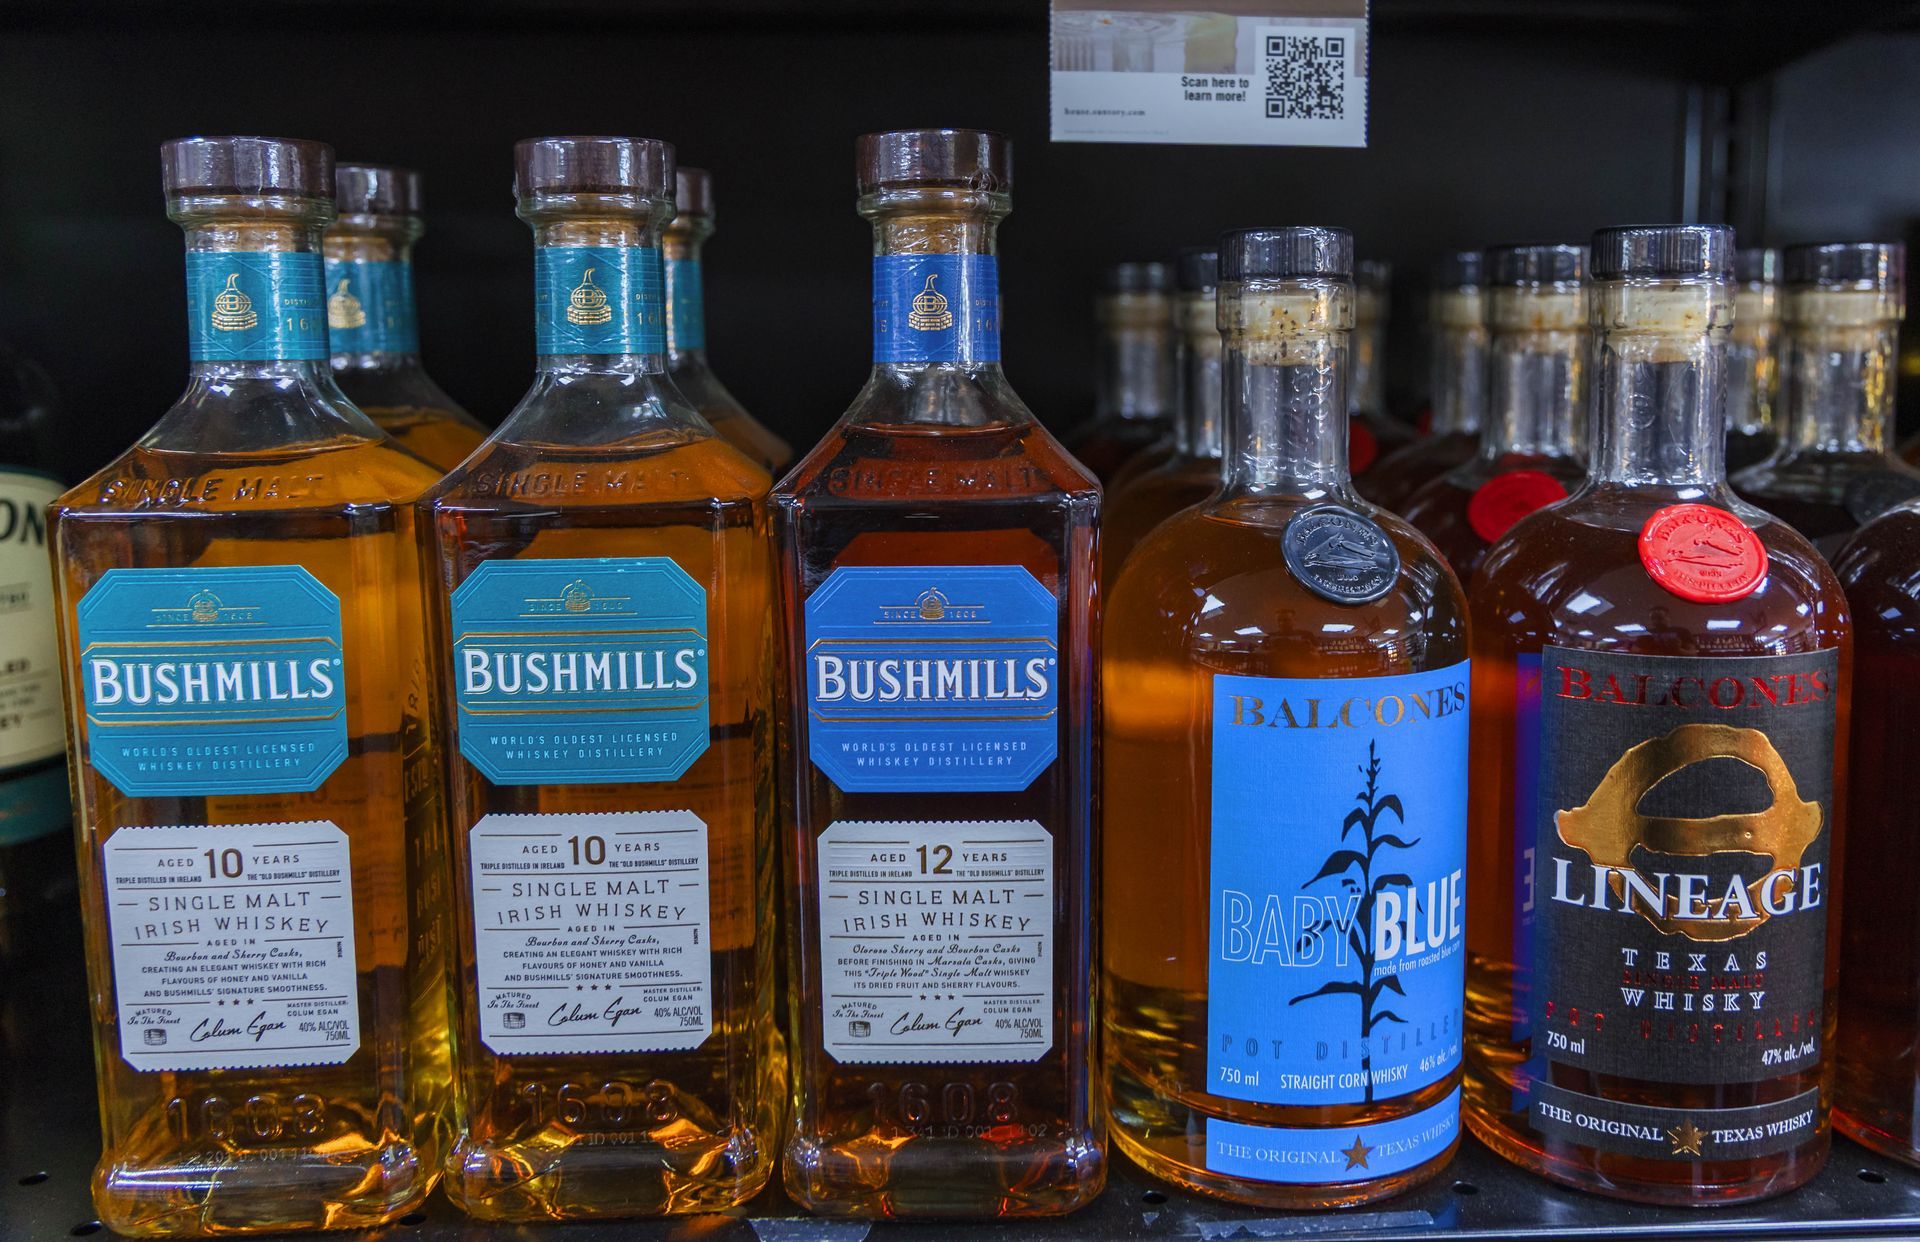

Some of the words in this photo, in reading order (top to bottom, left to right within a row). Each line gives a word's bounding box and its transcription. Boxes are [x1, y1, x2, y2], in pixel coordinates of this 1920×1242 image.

[1181, 77, 1208, 88] Scan
[1212, 77, 1236, 89] here
[1239, 79, 1249, 88] to
[1185, 91, 1212, 101] learn
[1216, 92, 1246, 102] more!
[463, 648, 698, 694] BUSHMILLS
[815, 655, 1048, 702] BUSHMILLS
[89, 658, 334, 705] BUSHMILLS
[1556, 666, 1830, 710] BALCONES
[1229, 682, 1465, 728] BALCONES
[491, 736, 545, 745] WORLD'S
[555, 735, 603, 744] OLDEST
[613, 733, 677, 743] LICENSED
[842, 743, 896, 751] WORLD'S
[905, 743, 954, 751] OLDEST
[963, 742, 1027, 751] LICENSED
[123, 748, 177, 756] WORLD'S
[187, 746, 237, 756] OLDEST
[247, 744, 314, 754] LICENSED
[506, 750, 568, 758] WHISKEY
[579, 748, 663, 758] DISTILLERY
[138, 761, 201, 771] WHISKEY
[213, 759, 301, 770] DISTILLERY
[857, 757, 919, 766] WHISKEY
[929, 757, 1012, 765] DISTILLERY
[568, 835, 605, 865] 10
[615, 843, 660, 852] YEARS
[871, 854, 906, 862] AGED
[916, 845, 952, 875] 12
[963, 853, 1007, 861] YEARS
[158, 858, 194, 867] AGED
[204, 848, 243, 879] 10
[253, 855, 300, 865] YEARS
[669, 858, 698, 866] DISTILLERY
[512, 882, 597, 897] SINGLE
[607, 880, 670, 895] MALT
[859, 891, 942, 905] SINGLE
[953, 889, 1014, 905] MALT
[1551, 857, 1821, 920] LINEAGE
[149, 895, 235, 911] SINGLE
[246, 892, 310, 908] MALT
[498, 905, 561, 925] IRISH
[576, 903, 686, 920] WHISKEY
[844, 913, 907, 932] IRISH
[921, 913, 1030, 931] WHISKEY
[1222, 890, 1361, 967] BABY
[1375, 869, 1461, 961] BLUE
[135, 919, 200, 939] IRISH
[215, 917, 328, 933] WHISKEY
[853, 945, 887, 954] Oloroso
[891, 944, 923, 956] Sherry
[927, 945, 943, 954] and
[946, 945, 989, 954] Bourbon
[993, 944, 1020, 953] Casks
[1622, 947, 1767, 972] TEXAS
[927, 956, 971, 965] Marsala
[975, 956, 1006, 965] Casks,
[1374, 960, 1396, 976] made
[1399, 957, 1417, 973] from
[1418, 952, 1440, 967] roasted
[1438, 947, 1451, 963] blue
[162, 977, 205, 985] FLAVOURS
[221, 975, 249, 983] HONEY
[252, 974, 269, 982] AND
[272, 973, 307, 981] VANILLA
[931, 968, 961, 979] Single
[964, 968, 992, 977] Malt
[1622, 969, 1700, 990] SINGLE
[1711, 972, 1766, 990] MALT
[164, 988, 214, 997] BUSHMILLS'
[217, 986, 265, 994] SIGNATURE
[268, 984, 328, 993] SMOOTHNESS.
[1621, 988, 1766, 1012] WHISKY
[654, 1007, 671, 1017] 40%
[673, 1006, 703, 1016] ALC/VOL
[680, 1016, 703, 1026] 750ML
[1546, 1001, 1604, 1032] POT
[299, 1023, 316, 1031] 40%
[318, 1020, 349, 1030] ALC/VOL
[890, 1012, 940, 1036] Colum
[945, 1007, 983, 1037] Egan
[995, 1020, 1011, 1028] 40%
[1014, 1019, 1043, 1028] ALC/VOL
[325, 1031, 350, 1040] 750ML
[1020, 1029, 1043, 1038] 750ML
[1221, 1033, 1282, 1060] POT
[1547, 1031, 1567, 1050] 750
[1571, 1039, 1585, 1055] ml
[1762, 1045, 1782, 1066] 47%
[1220, 1067, 1241, 1084] 750
[1244, 1071, 1259, 1086] ml
[1281, 1074, 1335, 1090] STRAIGHT
[1338, 1073, 1368, 1089] CORN
[1371, 1065, 1408, 1085] WHISKY
[1419, 1055, 1435, 1073] 46%
[867, 1082, 1019, 1124] 1608
[1539, 1102, 1572, 1123] THE
[1576, 1113, 1664, 1142] ORIGINAL
[1712, 1126, 1763, 1143] TEXAS
[1766, 1110, 1814, 1137] WHISKY
[1217, 1141, 1251, 1159] THE
[1256, 1148, 1340, 1164] ORIGINAL
[1376, 1135, 1419, 1157] TEXAS
[1421, 1113, 1456, 1144] WHISKY
